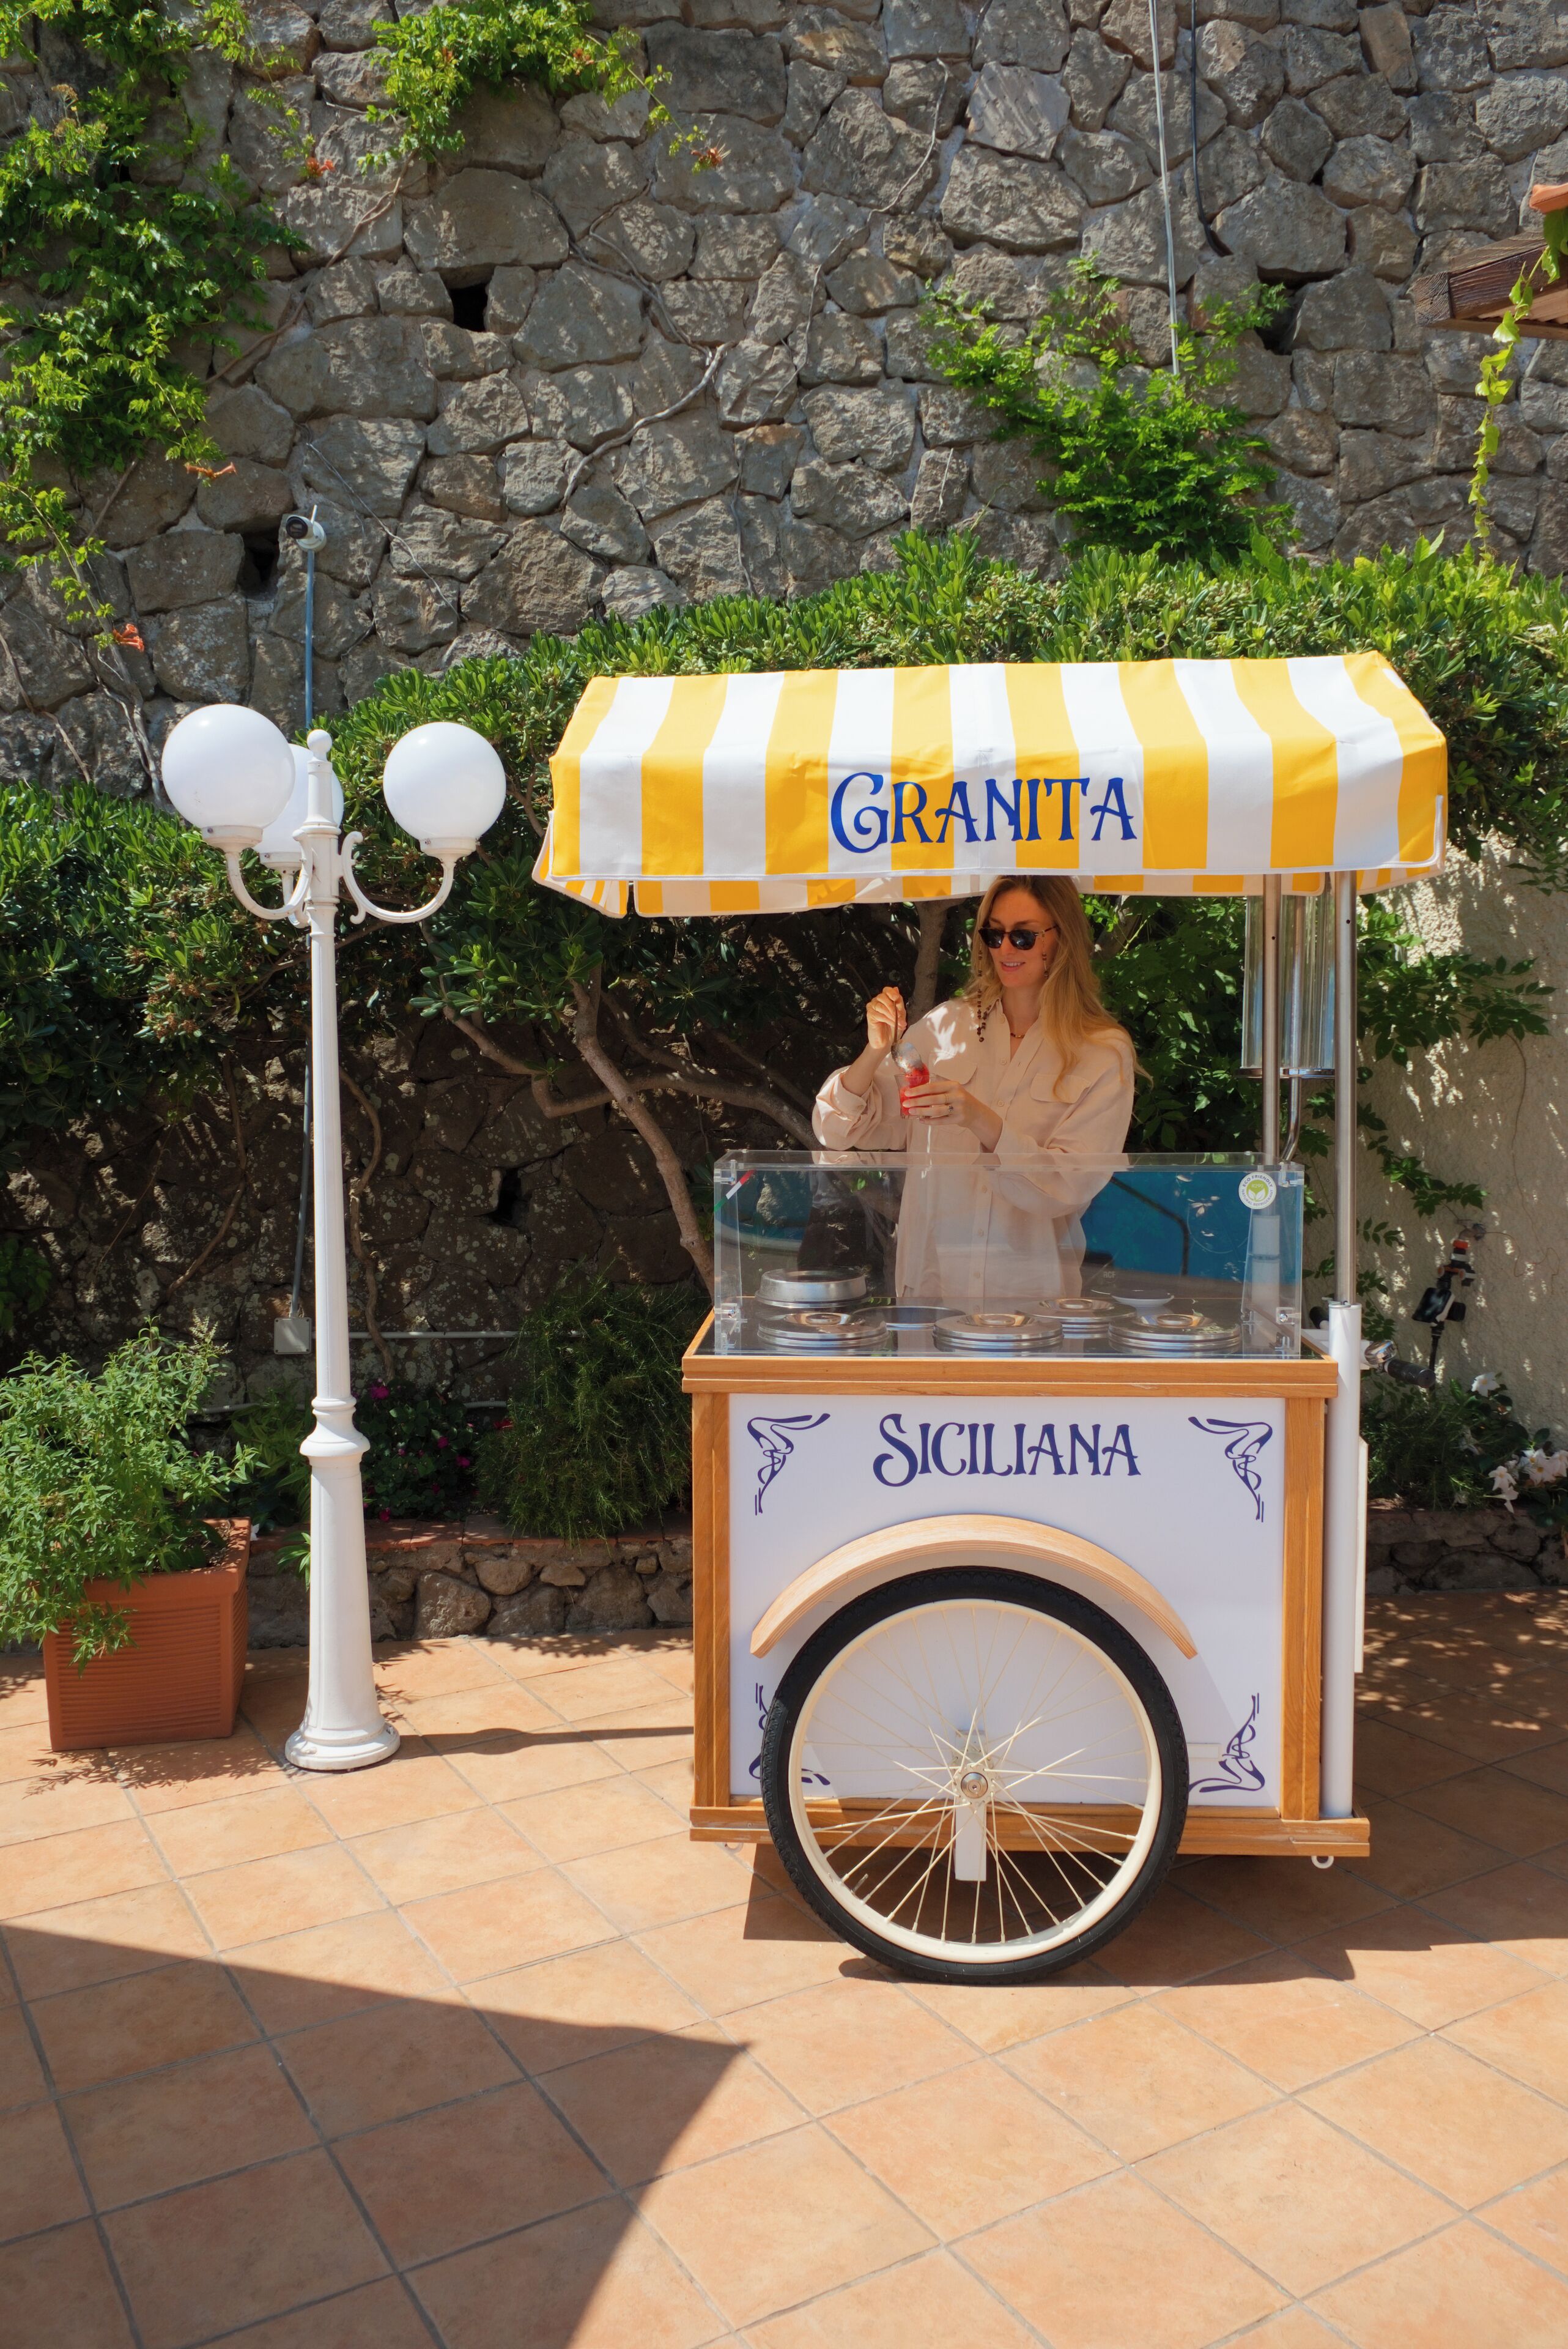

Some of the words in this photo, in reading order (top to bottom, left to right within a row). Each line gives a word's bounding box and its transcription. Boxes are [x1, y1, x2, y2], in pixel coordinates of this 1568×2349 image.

[830, 772, 1137, 853] GRANITA
[1241, 1189, 1253, 1205] NATURAL
[1252, 1174, 1273, 1187] FRIENDLY
[873, 1413, 1142, 1487] SICILIANA
